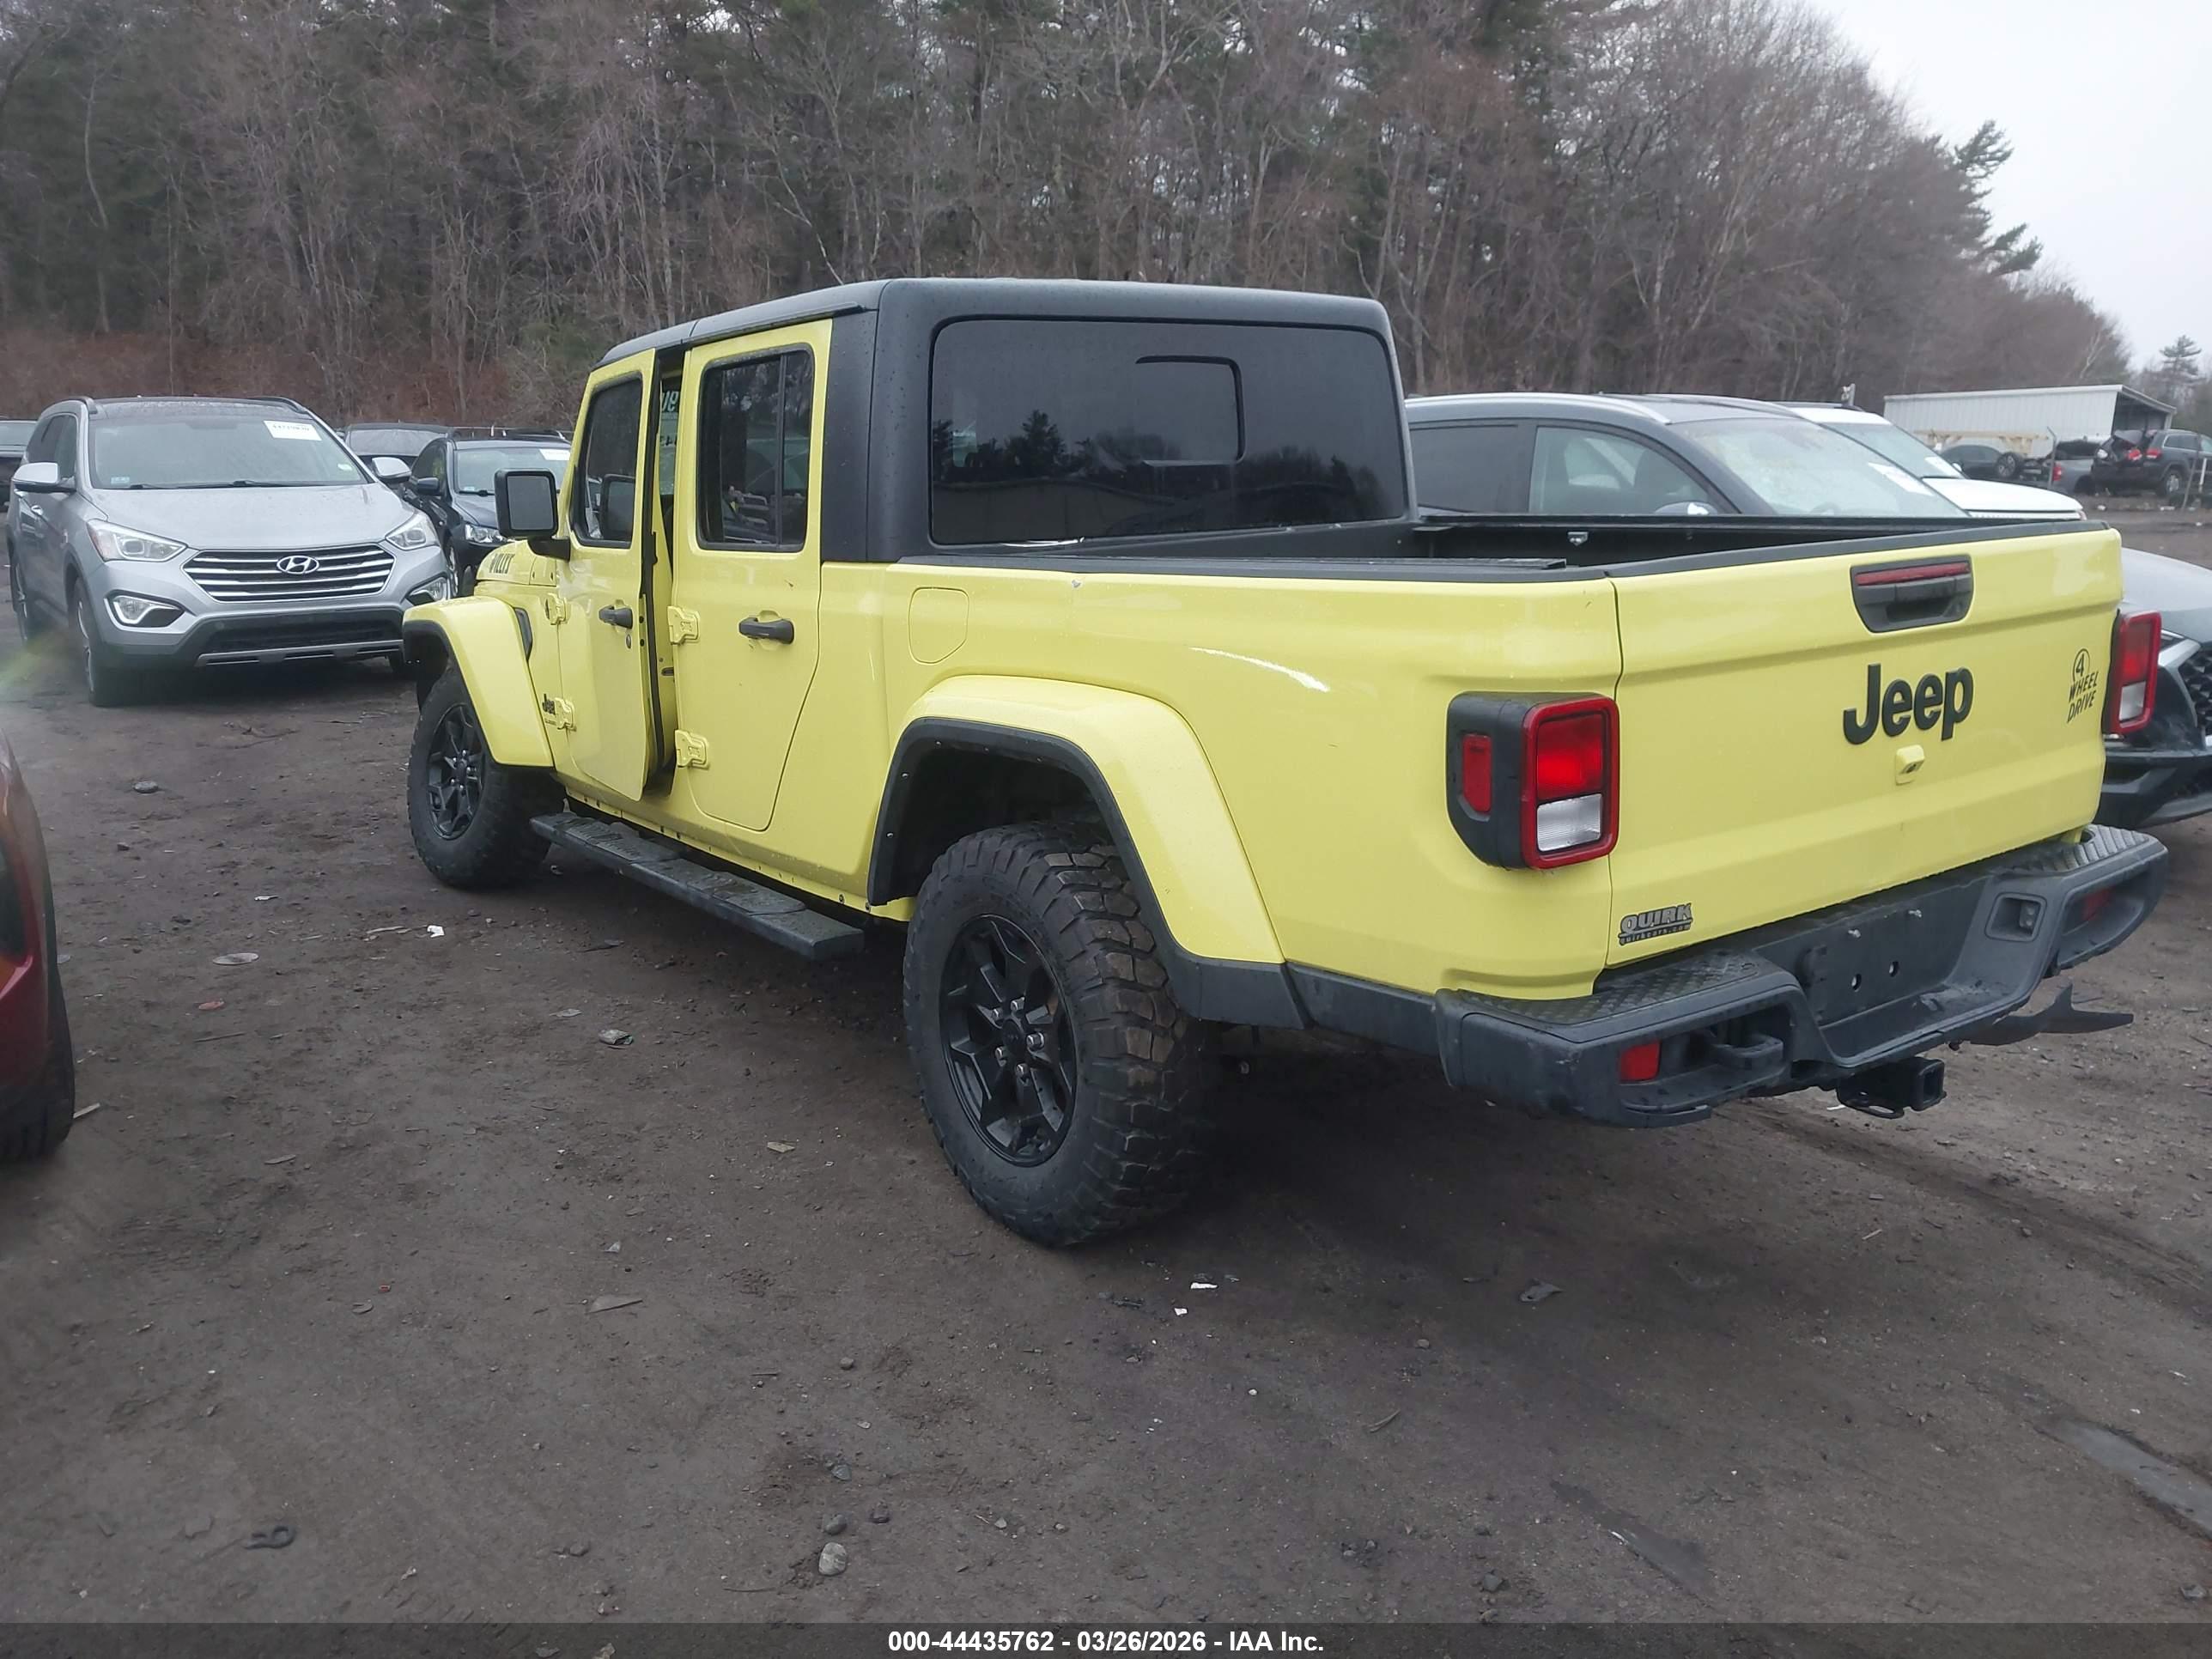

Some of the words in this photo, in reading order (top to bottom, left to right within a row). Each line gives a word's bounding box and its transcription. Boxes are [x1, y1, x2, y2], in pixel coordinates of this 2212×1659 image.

[2069, 670, 2100, 703] WHEEL
[1843, 663, 1974, 745] Jeep
[2066, 690, 2097, 723] DRIVE
[1620, 902, 1692, 933] QUIRK
